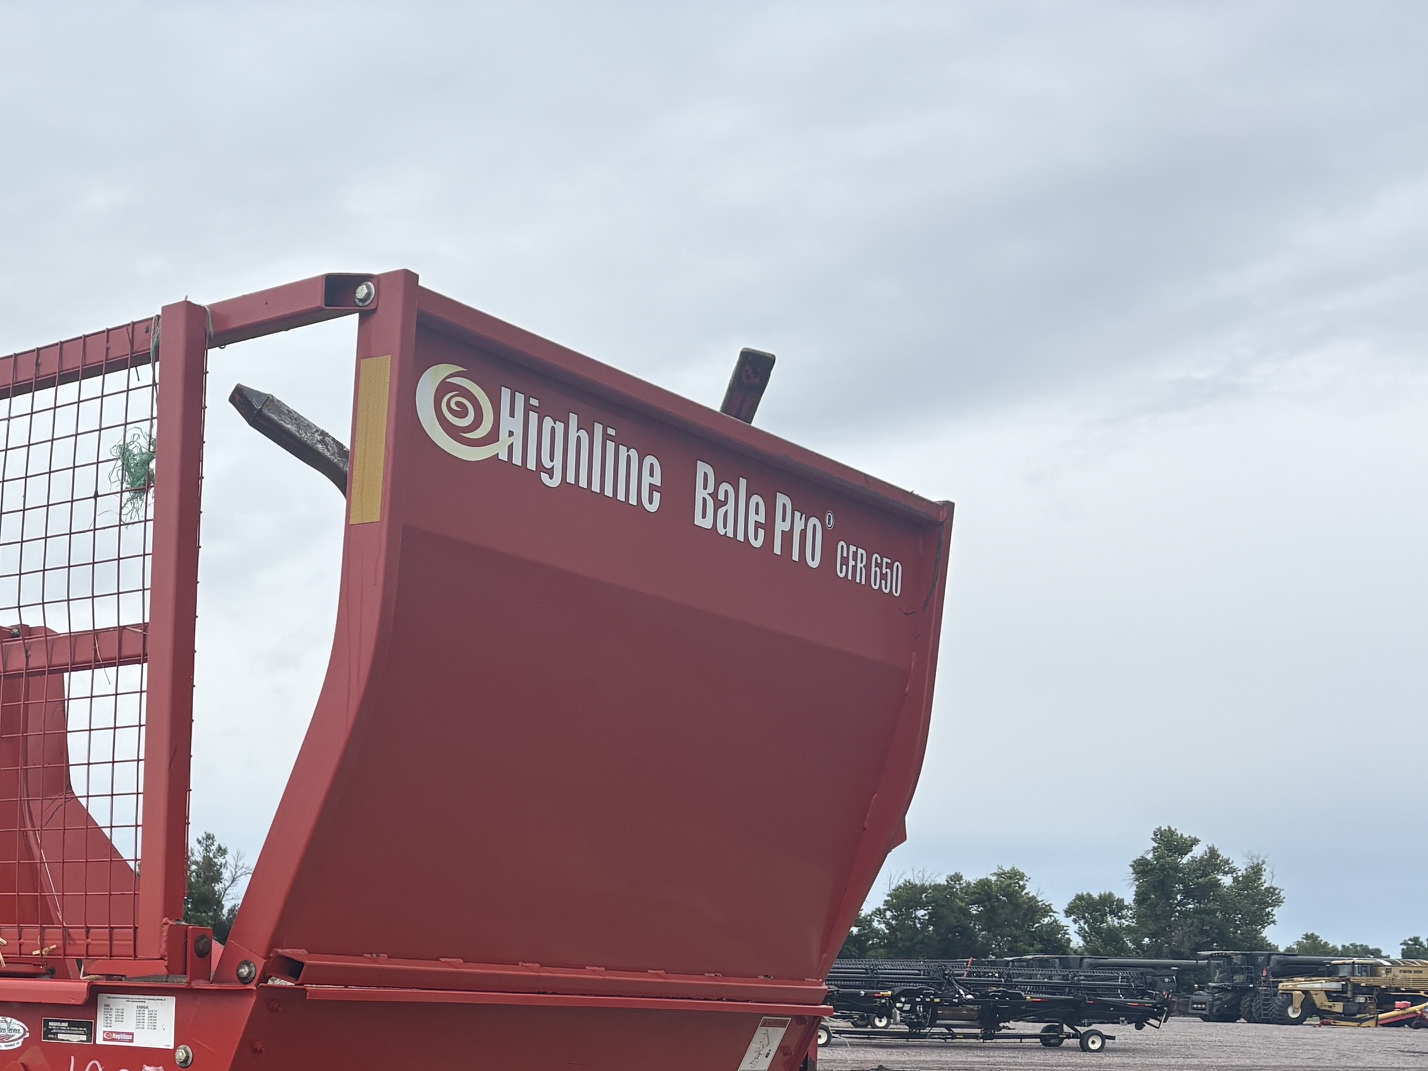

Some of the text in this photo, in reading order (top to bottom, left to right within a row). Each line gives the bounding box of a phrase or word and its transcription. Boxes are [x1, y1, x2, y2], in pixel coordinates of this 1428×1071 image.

[498, 385, 662, 513] Highline
[693, 459, 766, 549] Bale
[836, 540, 867, 585] CFR
[870, 553, 902, 597] 650
